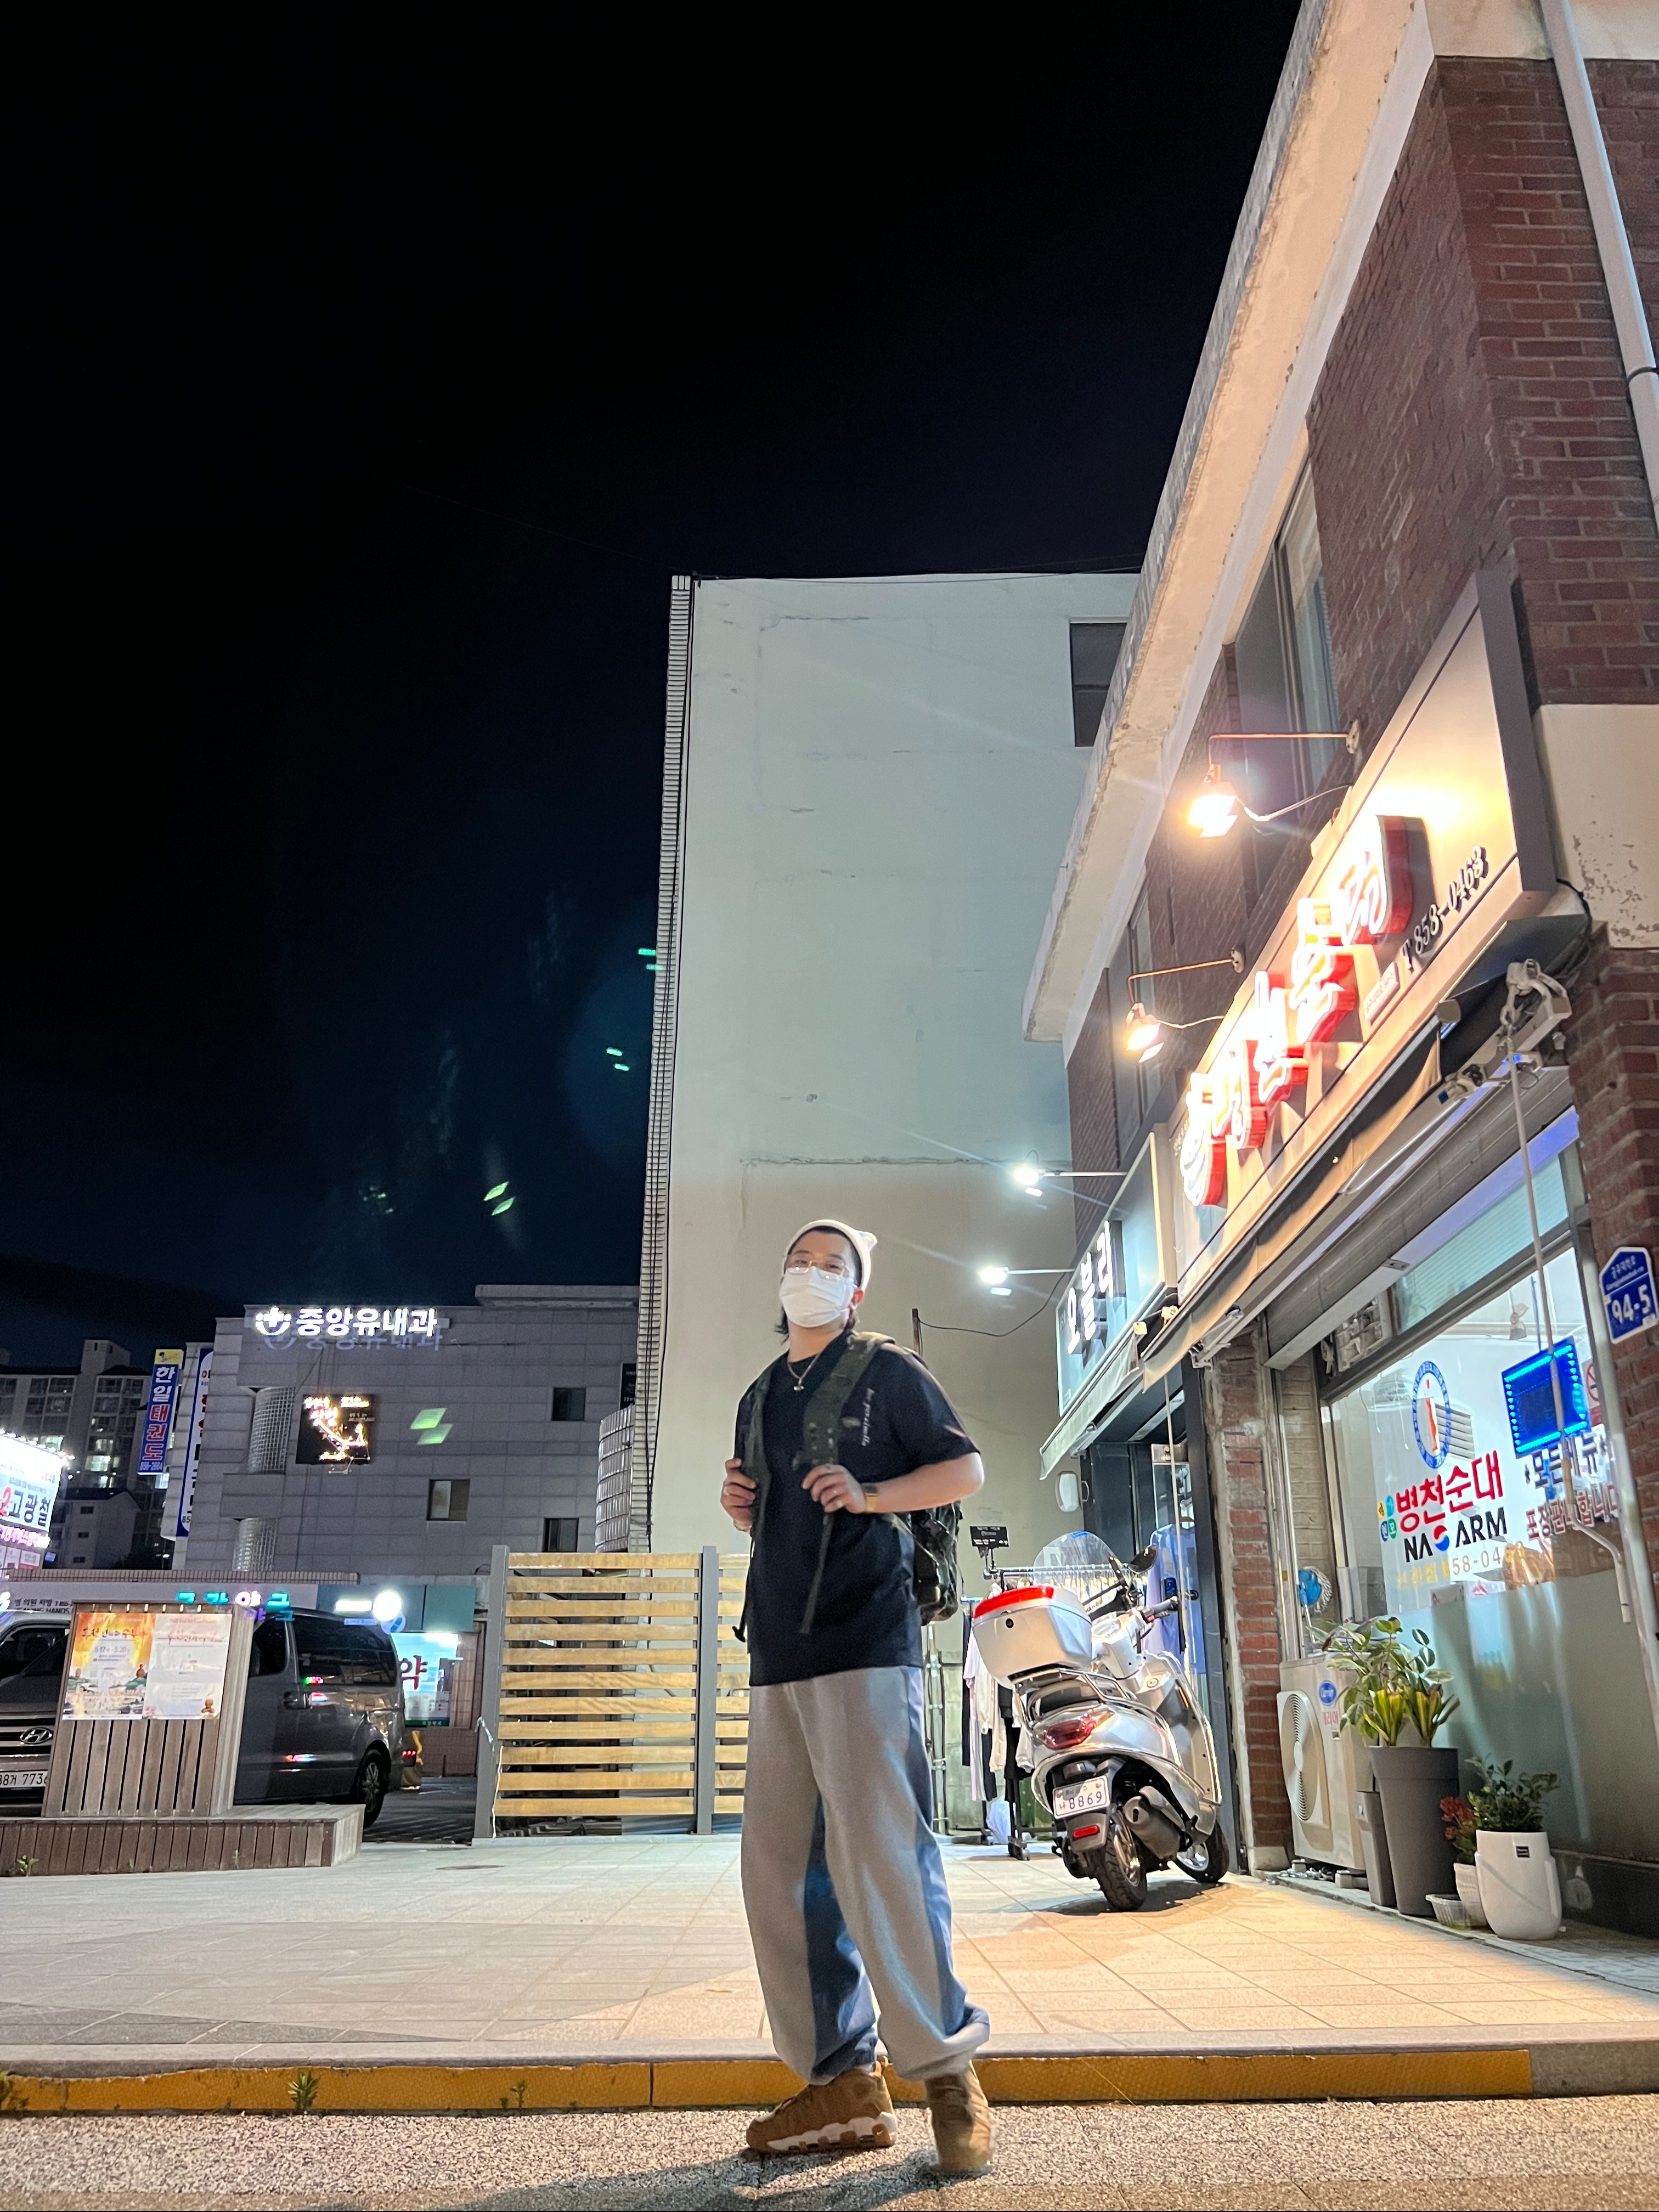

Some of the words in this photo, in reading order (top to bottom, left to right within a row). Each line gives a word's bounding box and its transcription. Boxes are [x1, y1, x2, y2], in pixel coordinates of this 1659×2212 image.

[1413, 845, 1486, 955] 858-0463
[296, 1307, 438, 1338] 중앙유내과
[1611, 1284, 1651, 1325] 94-5
[142, 1366, 176, 1461] 한일태권도
[1396, 1449, 1504, 1533] 병천순대
[22, 1773, 48, 1786] 773
[1069, 1791, 1102, 1810] 8869
